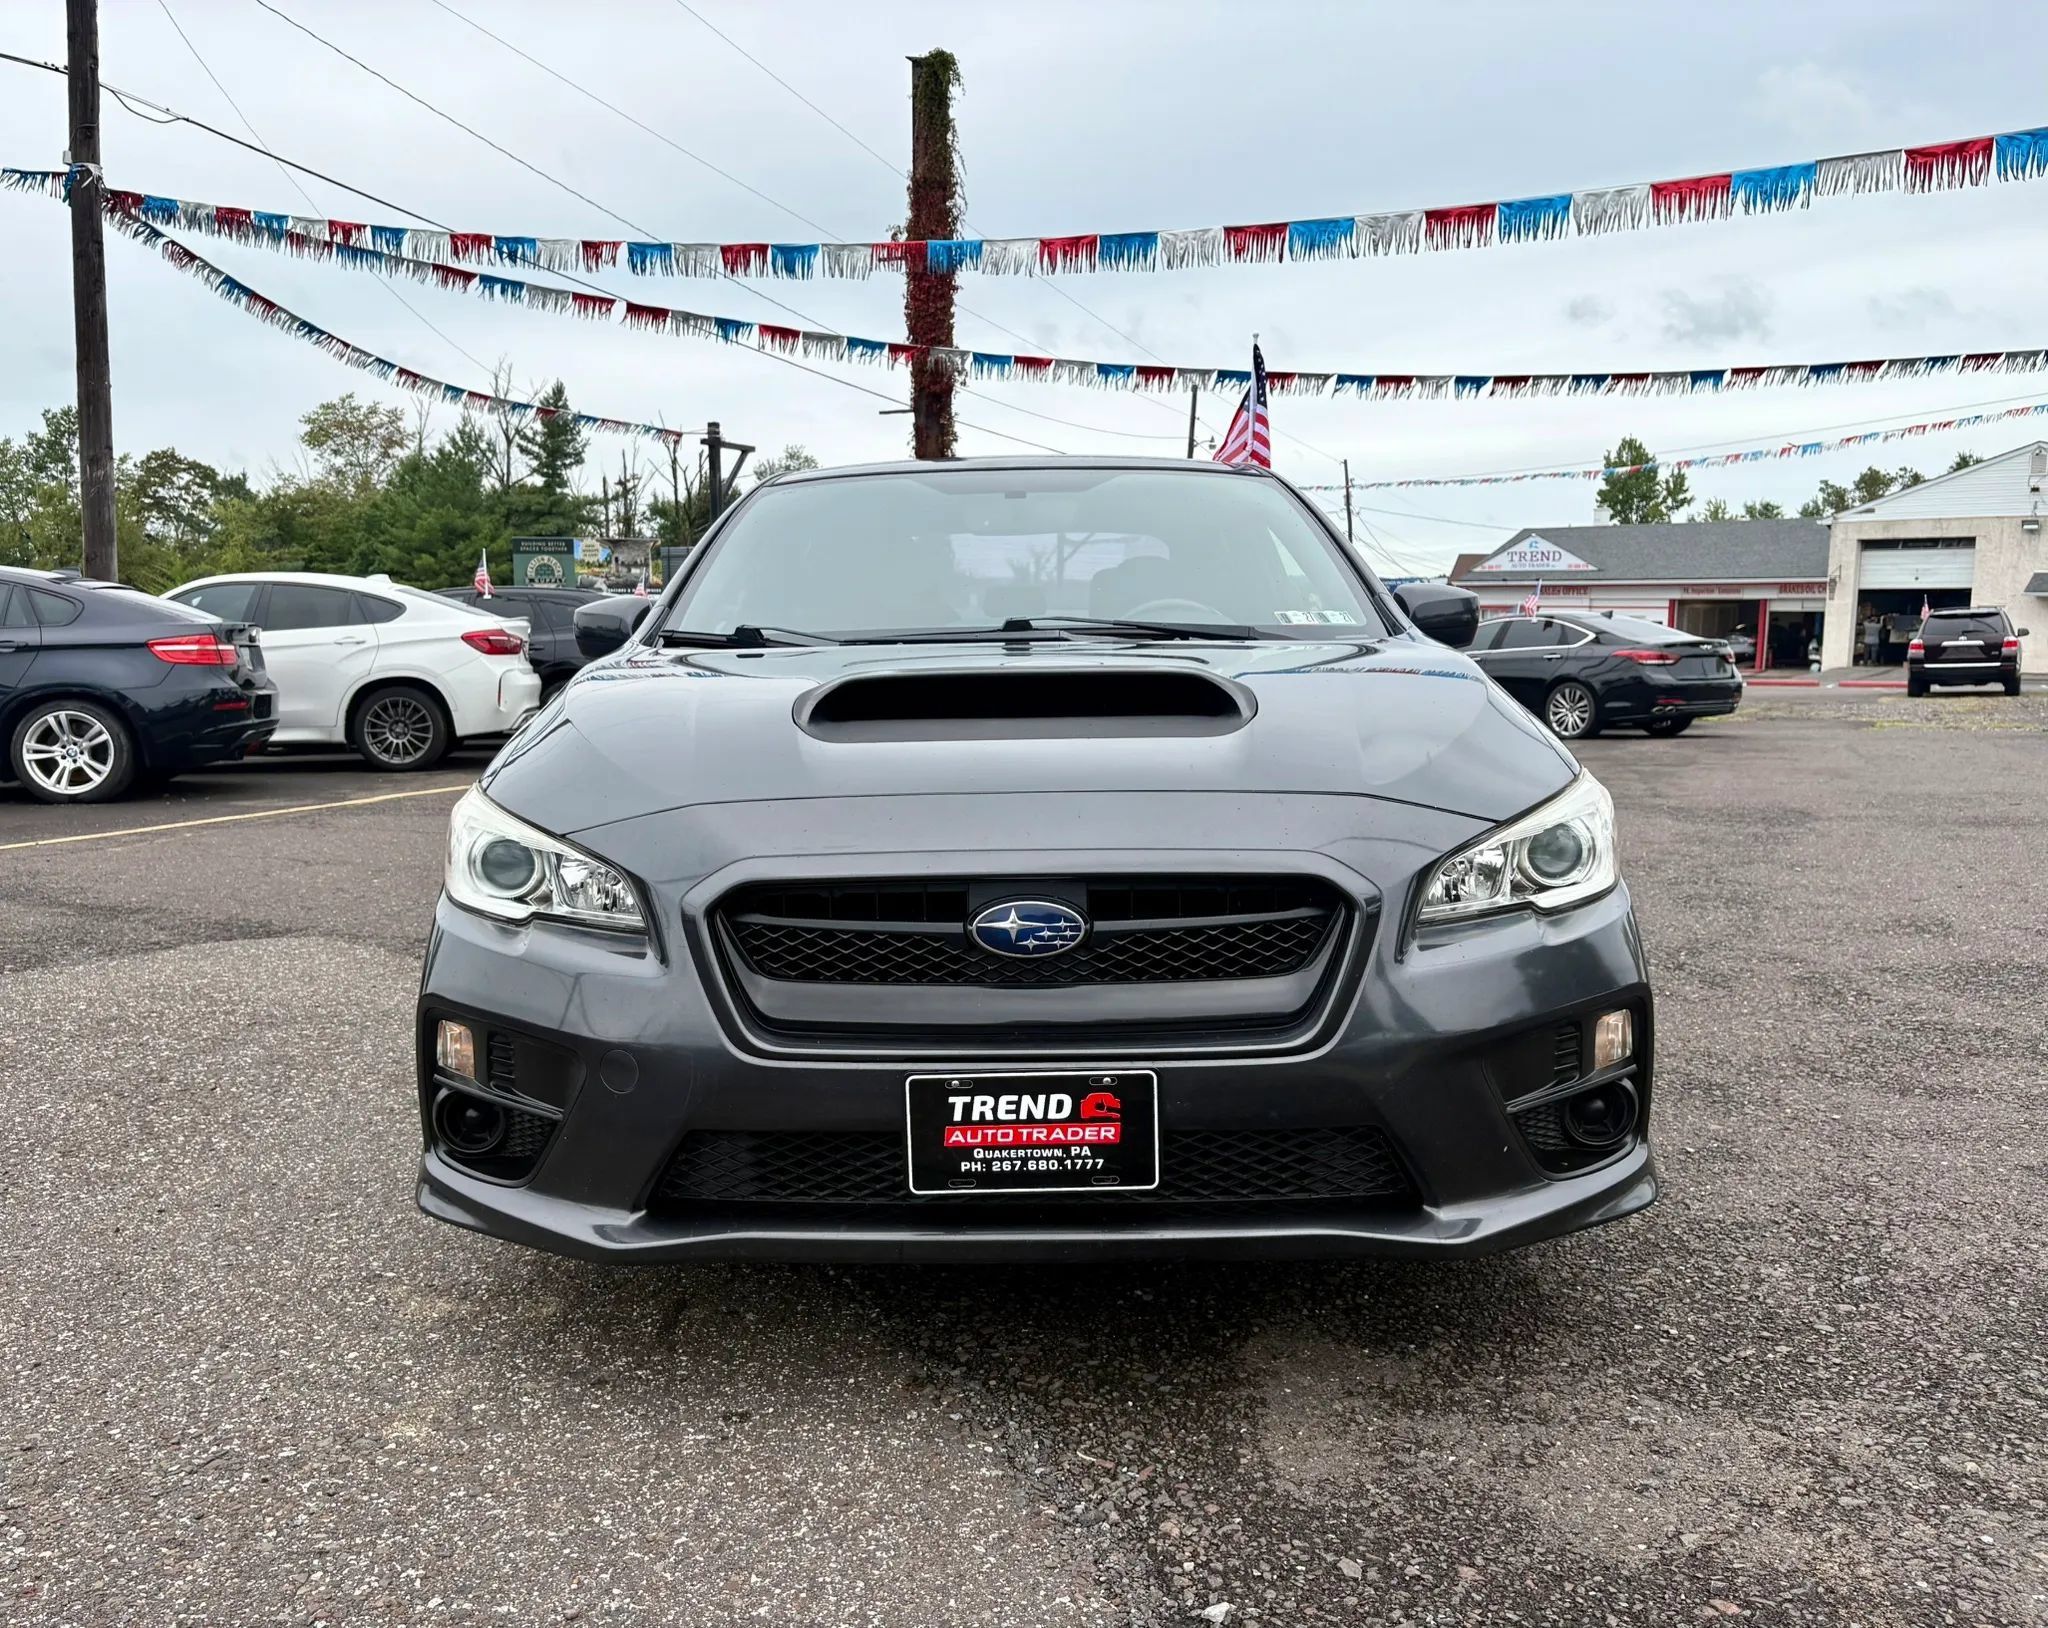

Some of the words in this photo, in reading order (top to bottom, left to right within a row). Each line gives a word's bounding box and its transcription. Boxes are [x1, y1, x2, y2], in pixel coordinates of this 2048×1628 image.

[1507, 551, 1562, 562] TREND
[1562, 585, 1588, 595] OFFICE
[948, 1094, 1073, 1121] TREND
[948, 1129, 1014, 1143] AUTO
[1018, 1126, 1116, 1142] TRADER
[1071, 1146, 1092, 1157] PA
[961, 1161, 987, 1173] PH:
[992, 1159, 1105, 1172] 267.680.1777
